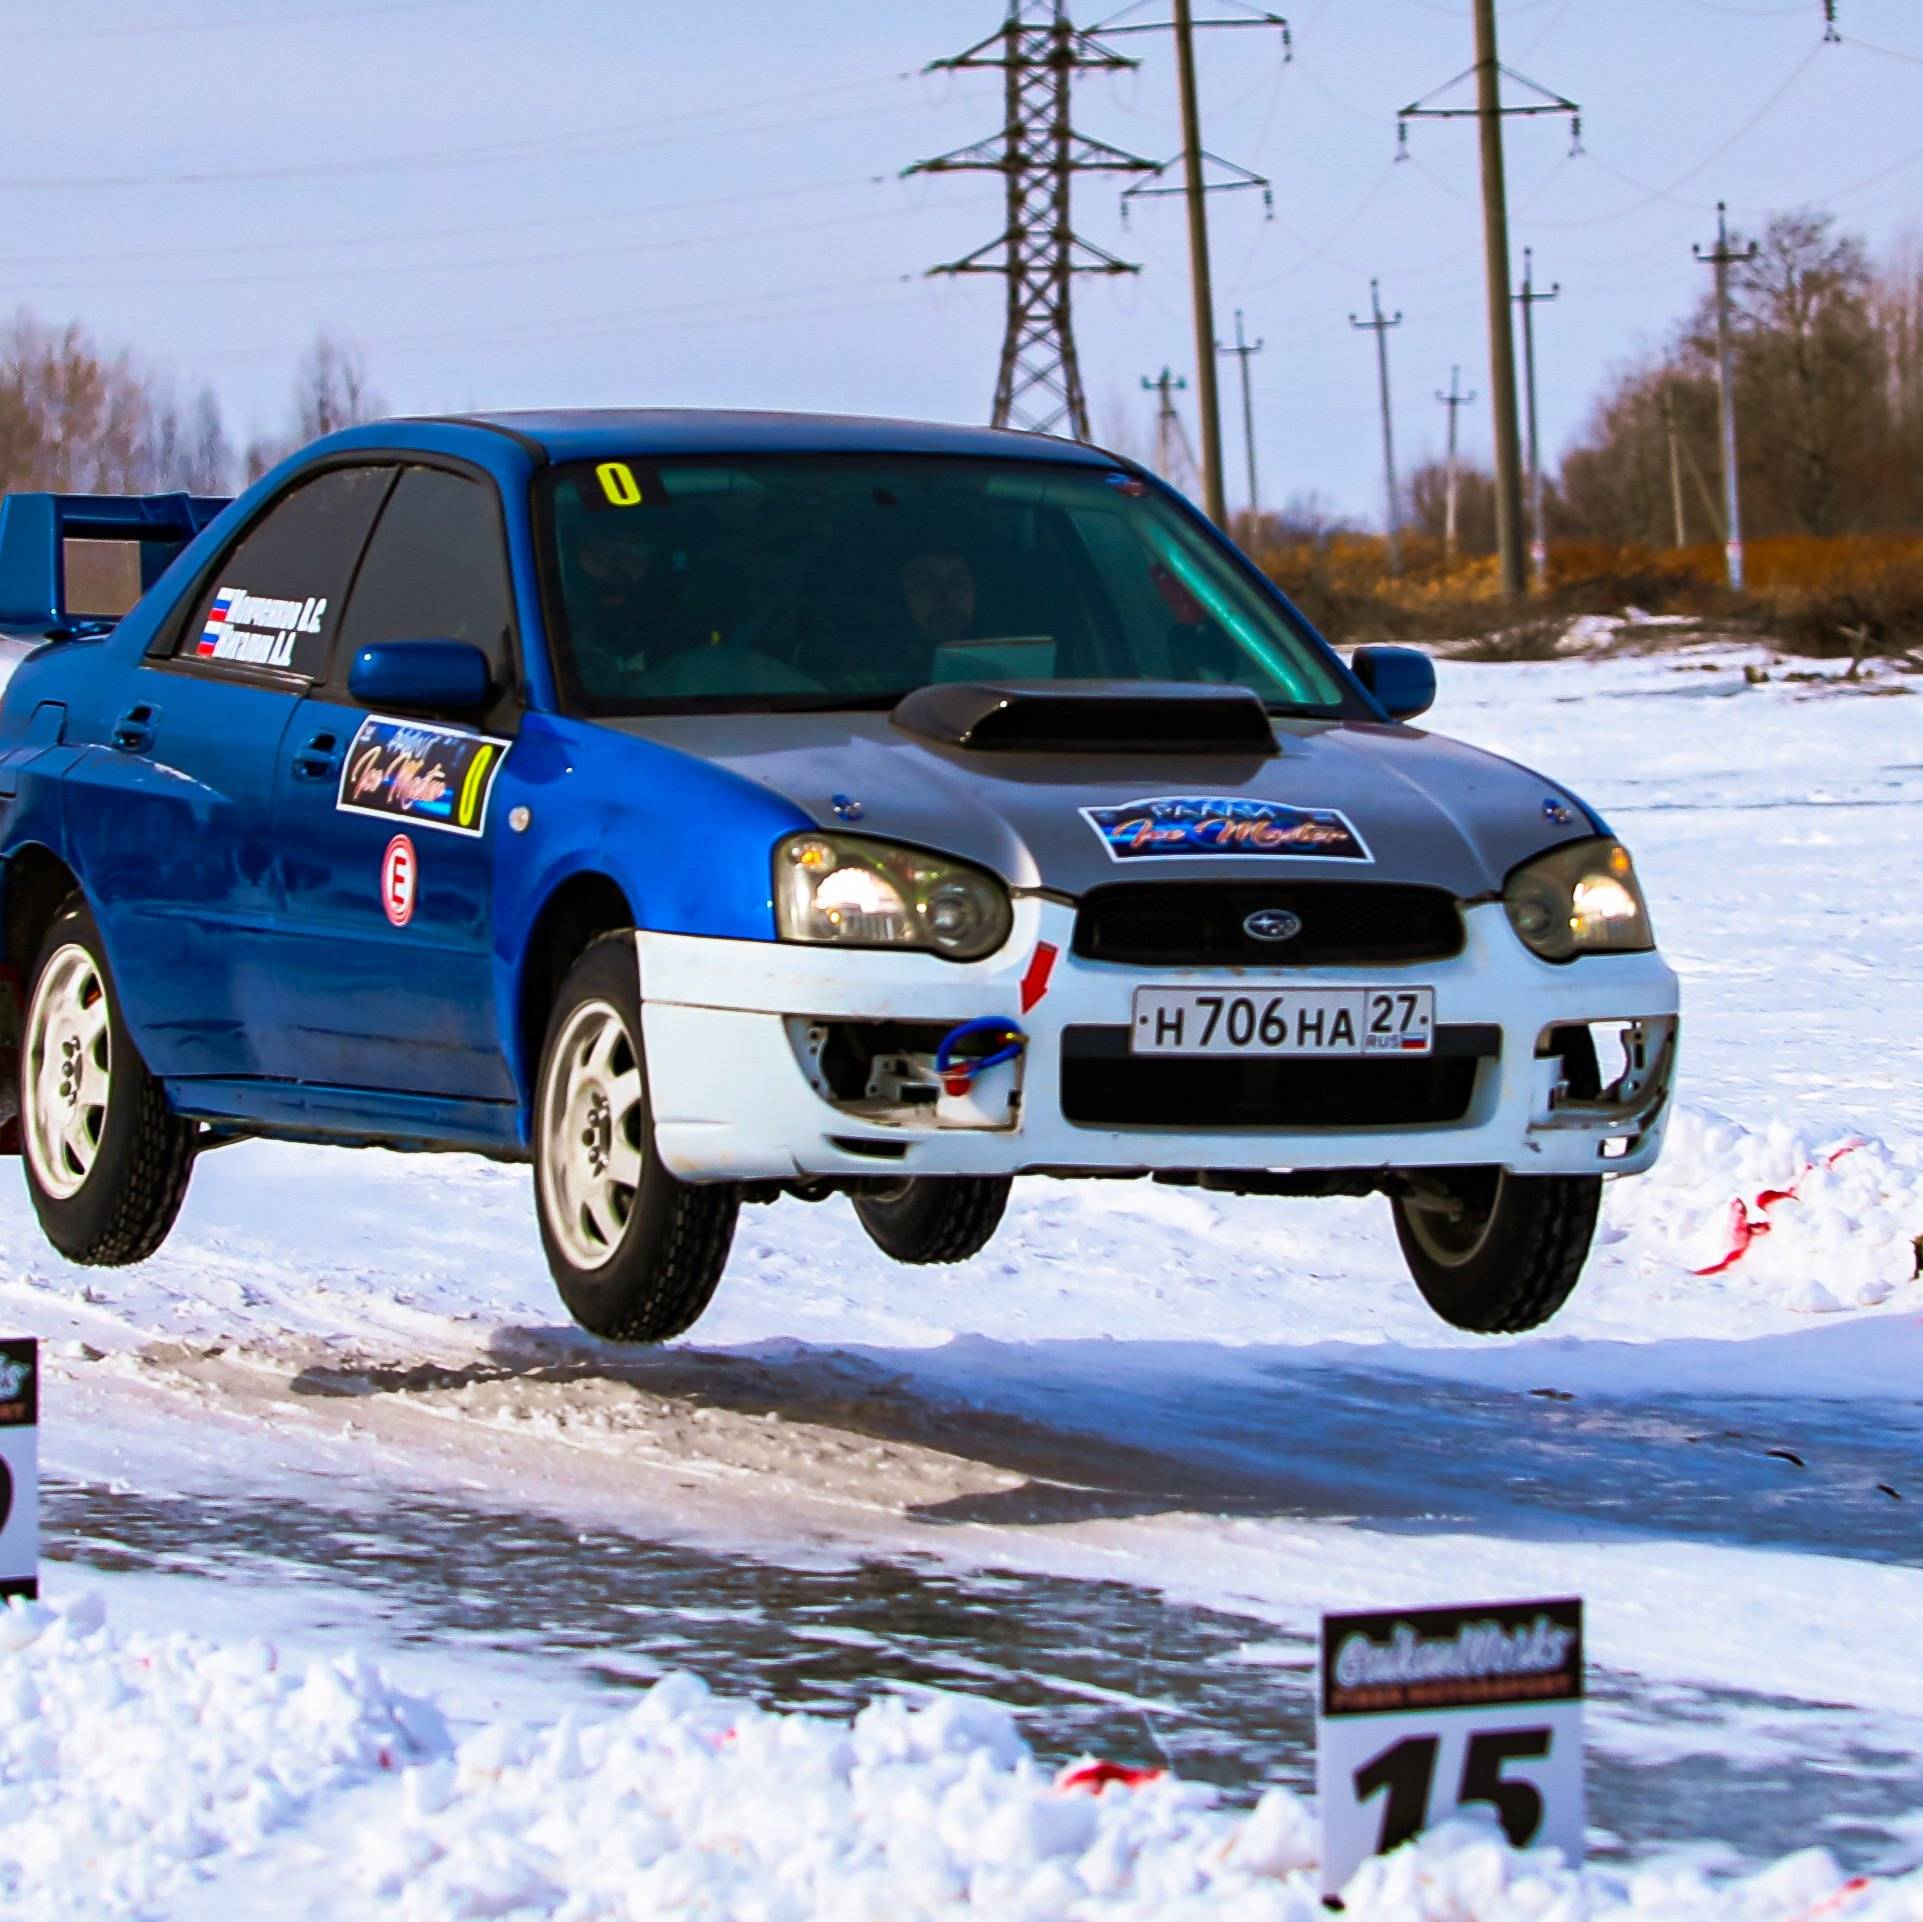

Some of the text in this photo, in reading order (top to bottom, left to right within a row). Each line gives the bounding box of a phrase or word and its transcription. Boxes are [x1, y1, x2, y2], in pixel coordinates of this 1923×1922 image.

[595, 462, 642, 507] 0
[391, 855, 408, 905] E
[1370, 994, 1418, 1033] 27
[1352, 1724, 1553, 1856] 15
